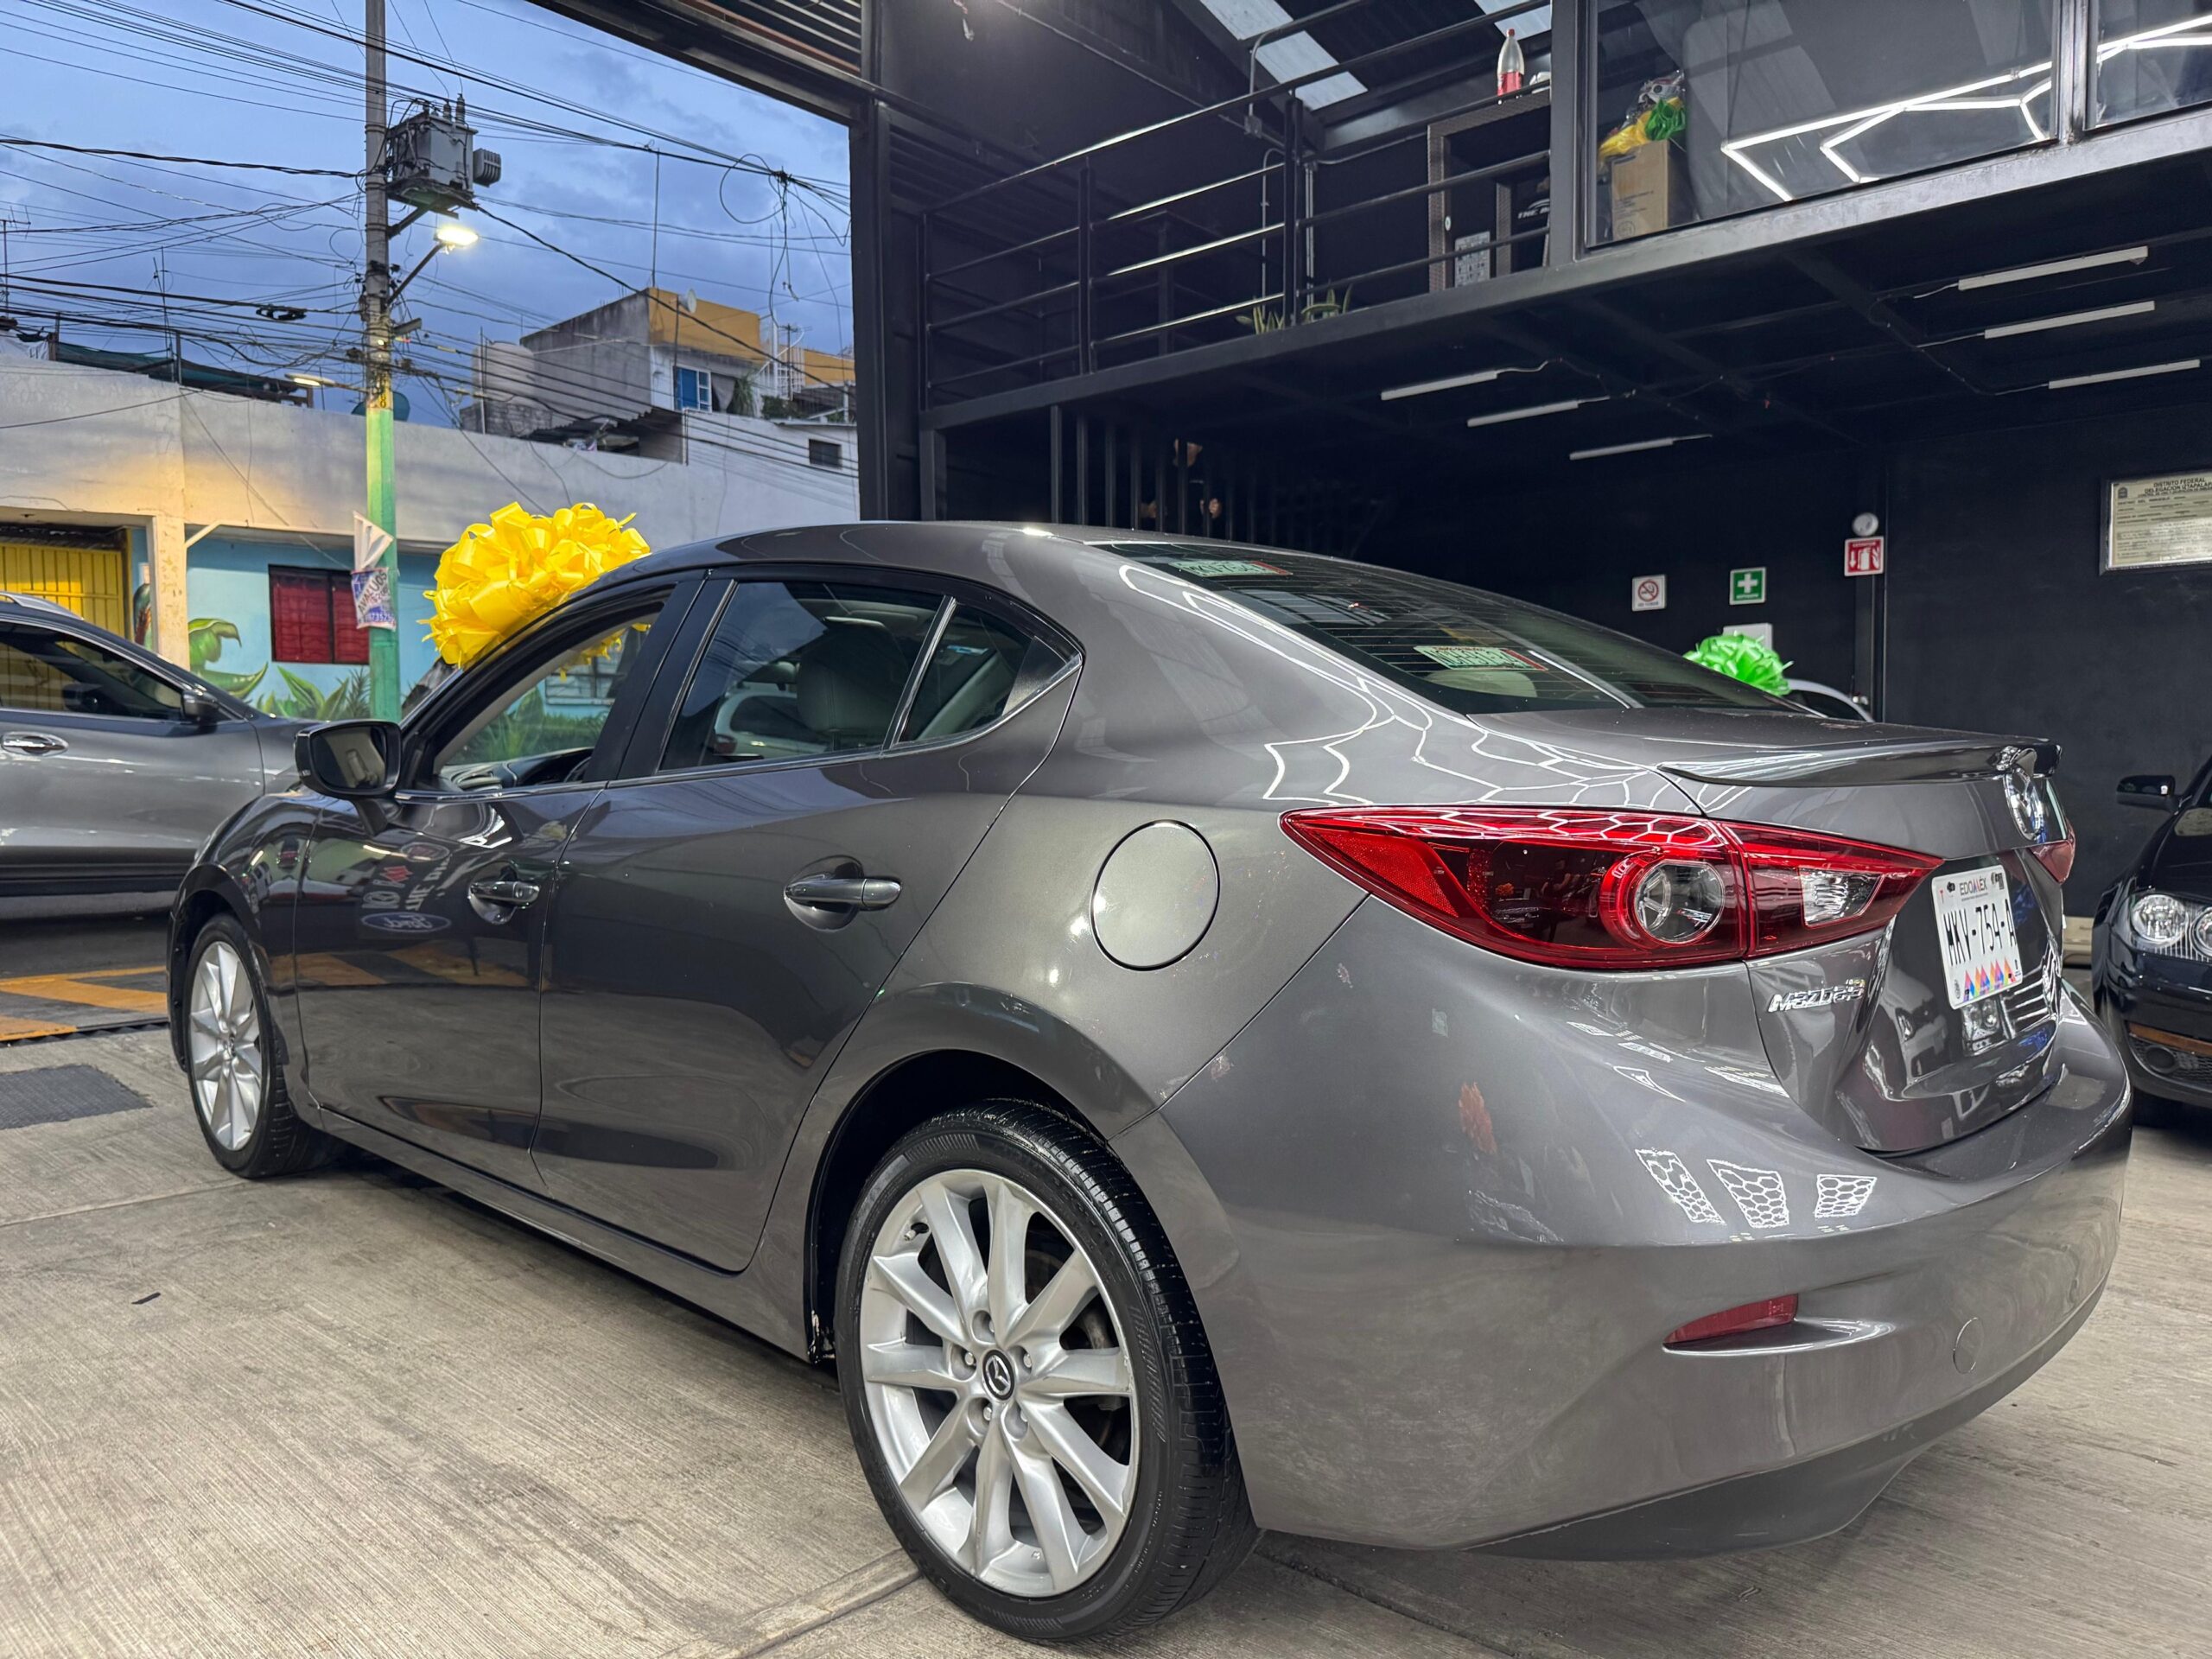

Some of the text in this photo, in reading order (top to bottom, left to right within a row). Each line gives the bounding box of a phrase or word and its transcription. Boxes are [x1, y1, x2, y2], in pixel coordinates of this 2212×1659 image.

[2180, 476, 2205, 485] FEDERAL
[358, 571, 387, 614] AVALUOS
[1942, 899, 2018, 967] MKV-754-A
